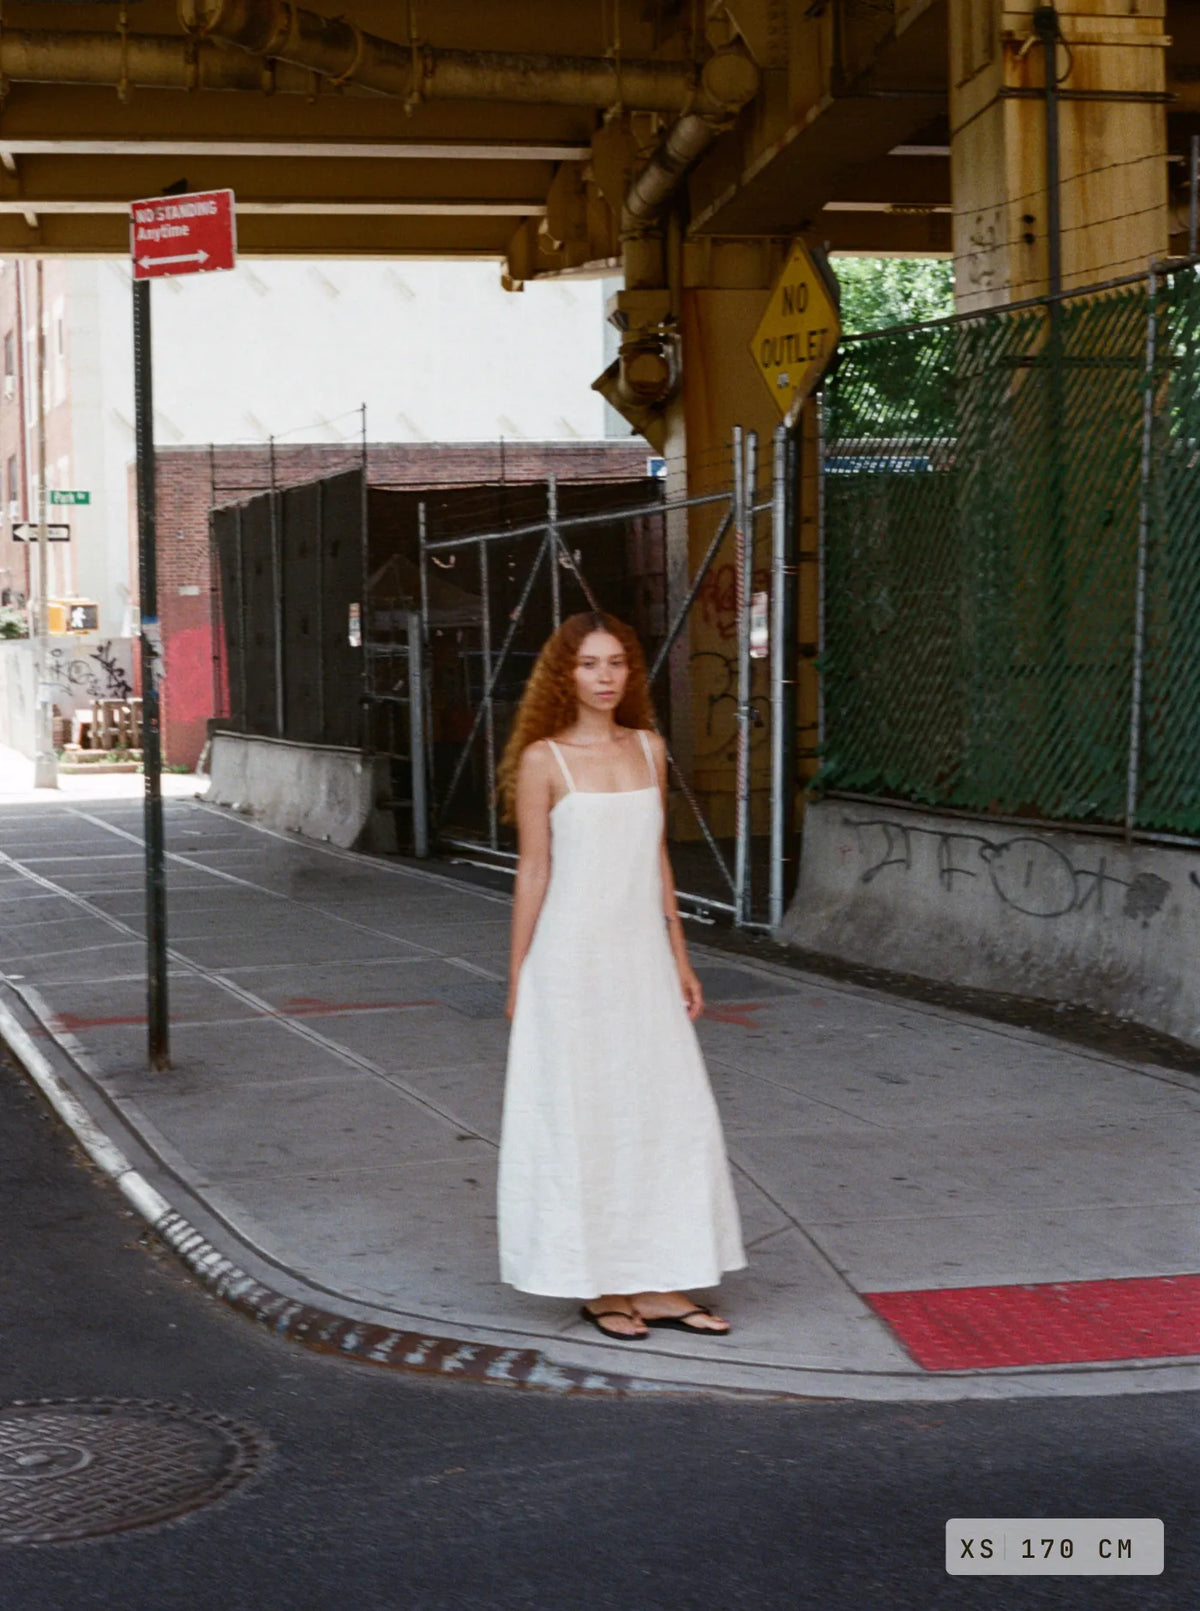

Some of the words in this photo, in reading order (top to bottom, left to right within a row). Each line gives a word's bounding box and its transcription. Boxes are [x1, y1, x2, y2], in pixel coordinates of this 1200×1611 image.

[135, 208, 154, 223] NO
[155, 200, 218, 221] STANDING
[137, 224, 190, 242] Anytime
[781, 281, 809, 317] NO
[761, 328, 829, 368] OUTLET
